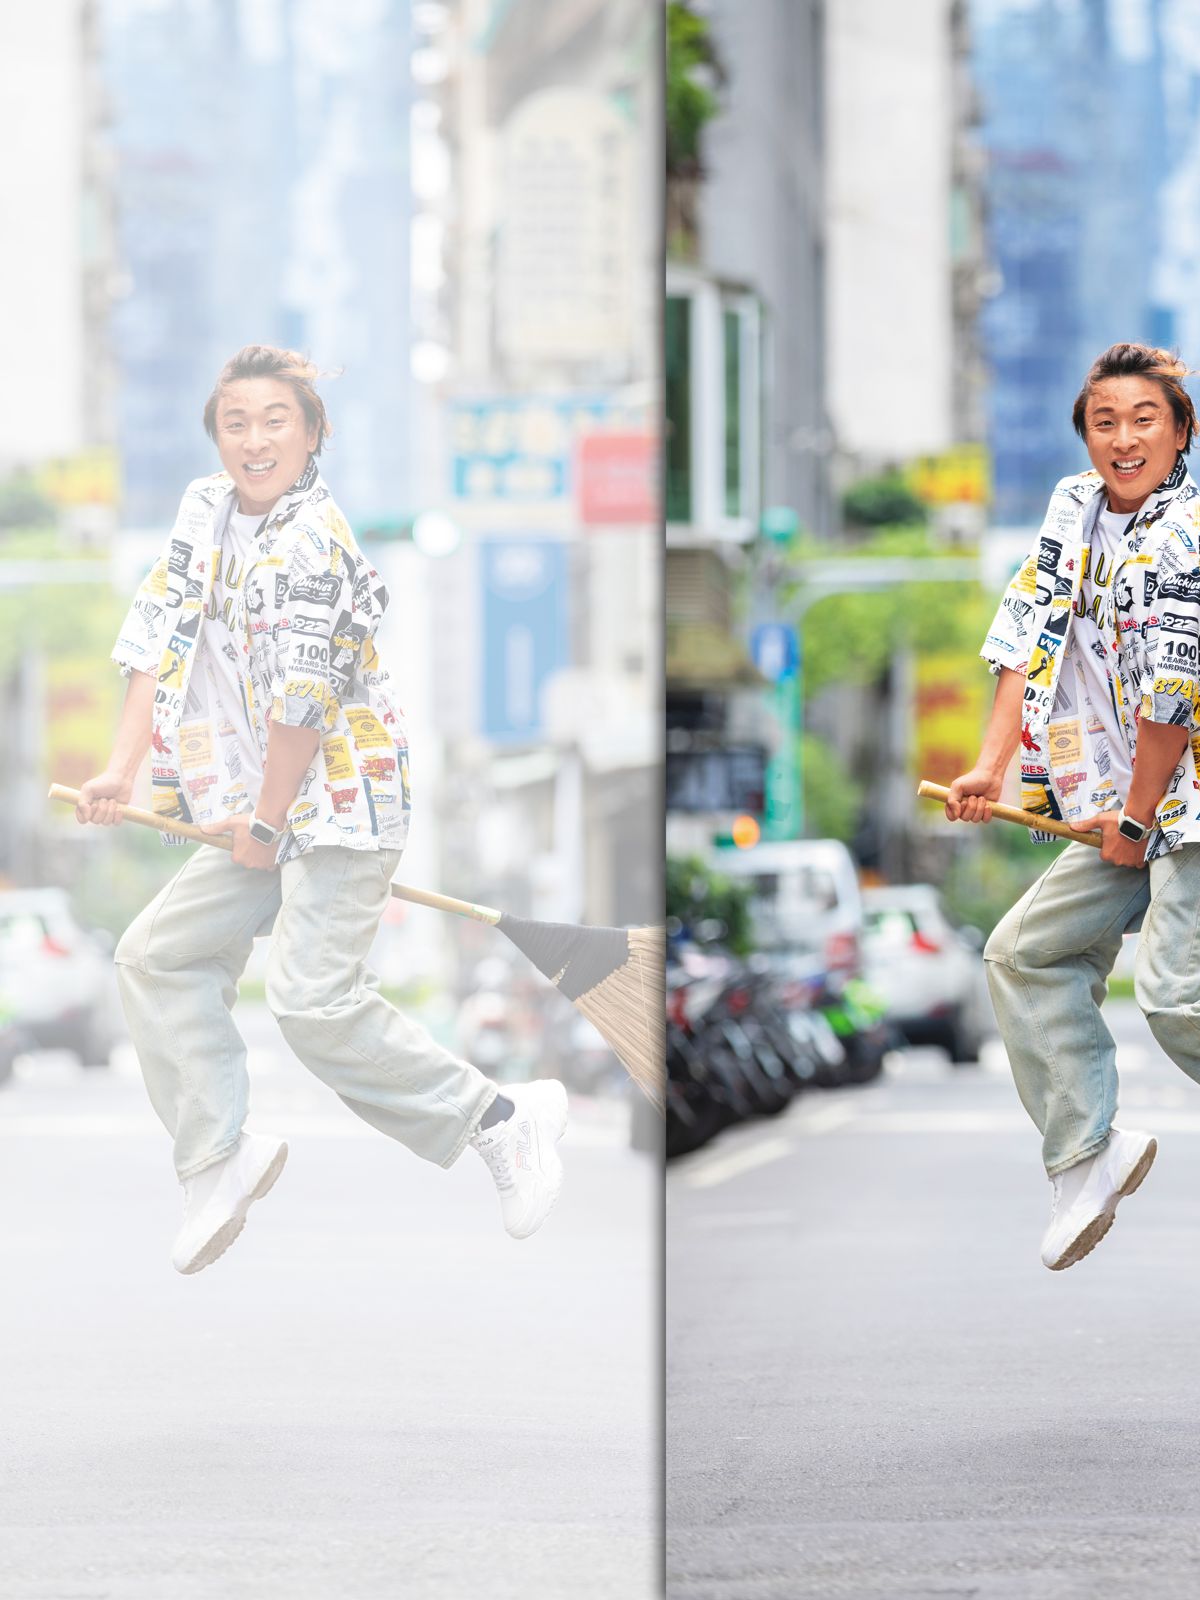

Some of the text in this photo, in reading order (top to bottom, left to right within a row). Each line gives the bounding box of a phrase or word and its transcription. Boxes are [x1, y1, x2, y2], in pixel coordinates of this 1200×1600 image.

[297, 577, 333, 592] Dickies
[294, 617, 323, 631] 922
[1163, 615, 1192, 629] 922
[296, 643, 328, 662] 100
[1164, 640, 1196, 660] 100
[1161, 656, 1188, 666] YEARS
[284, 680, 325, 702] 874
[1153, 678, 1194, 699] 874
[1158, 804, 1187, 823] 1922
